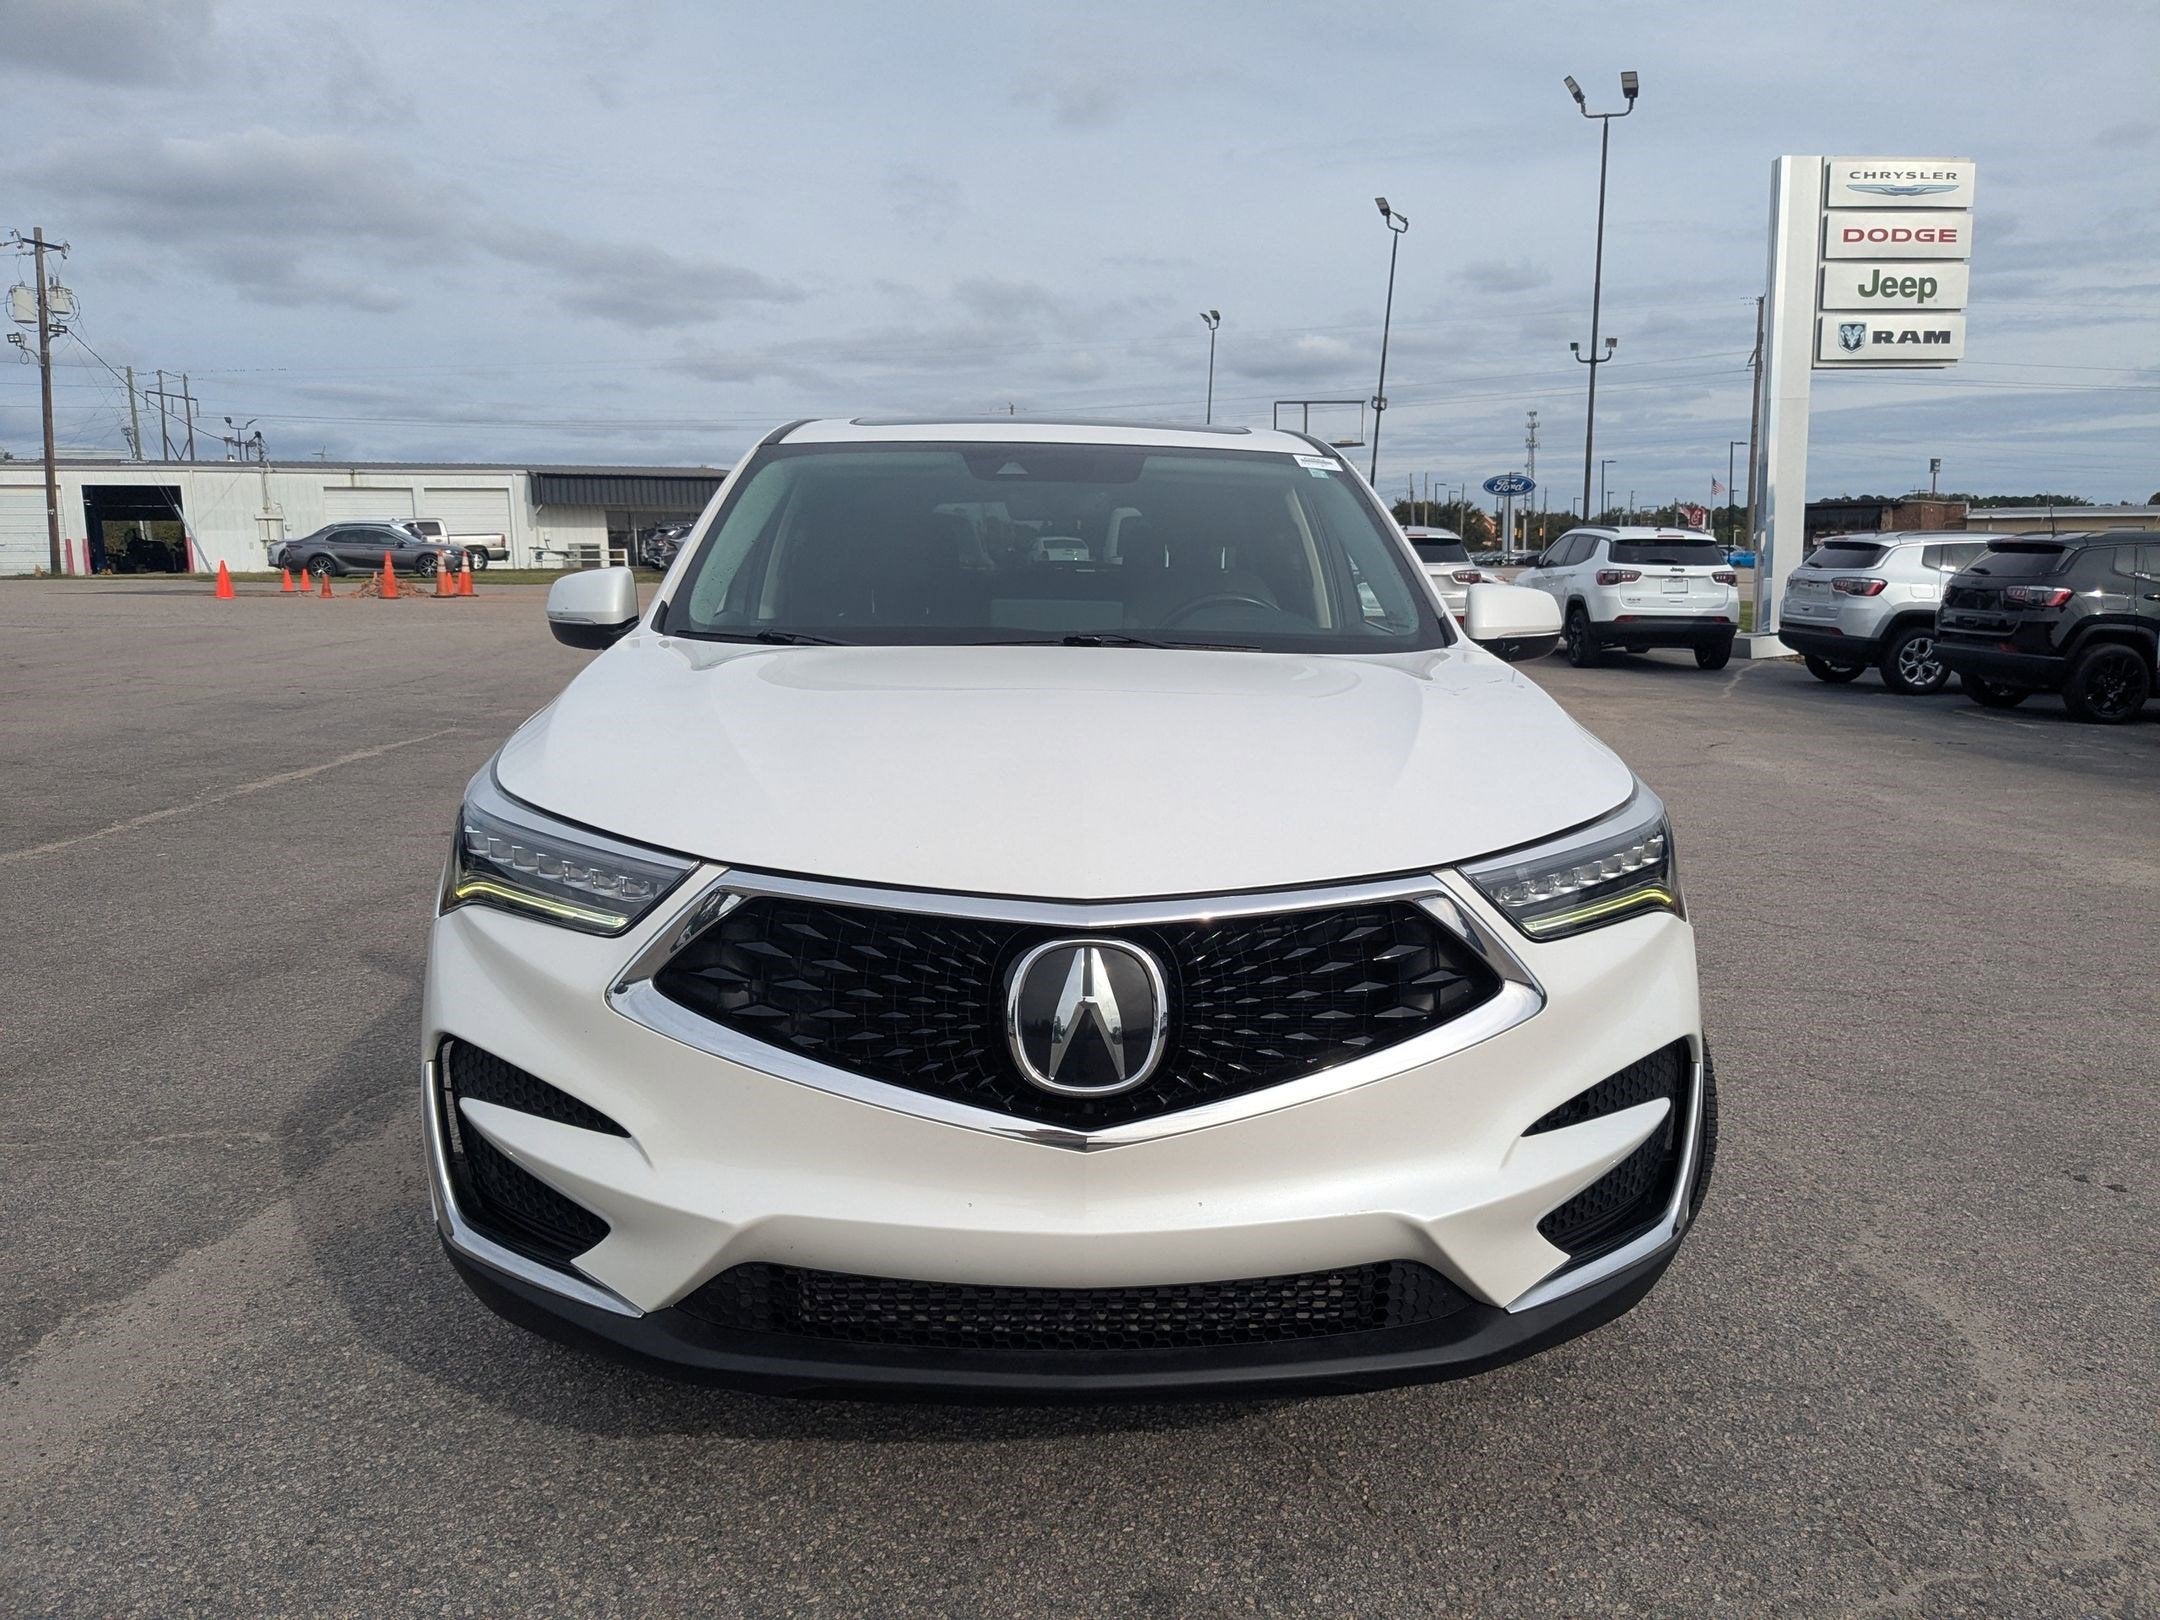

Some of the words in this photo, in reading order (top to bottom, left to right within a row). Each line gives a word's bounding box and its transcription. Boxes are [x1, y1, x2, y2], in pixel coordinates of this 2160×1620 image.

[1849, 171, 1958, 180] CHRYSLER
[1842, 228, 1958, 243] DODGE
[1857, 269, 1938, 304] Jeep
[1871, 330, 1951, 344] RAM
[1493, 478, 1526, 492] Ford
